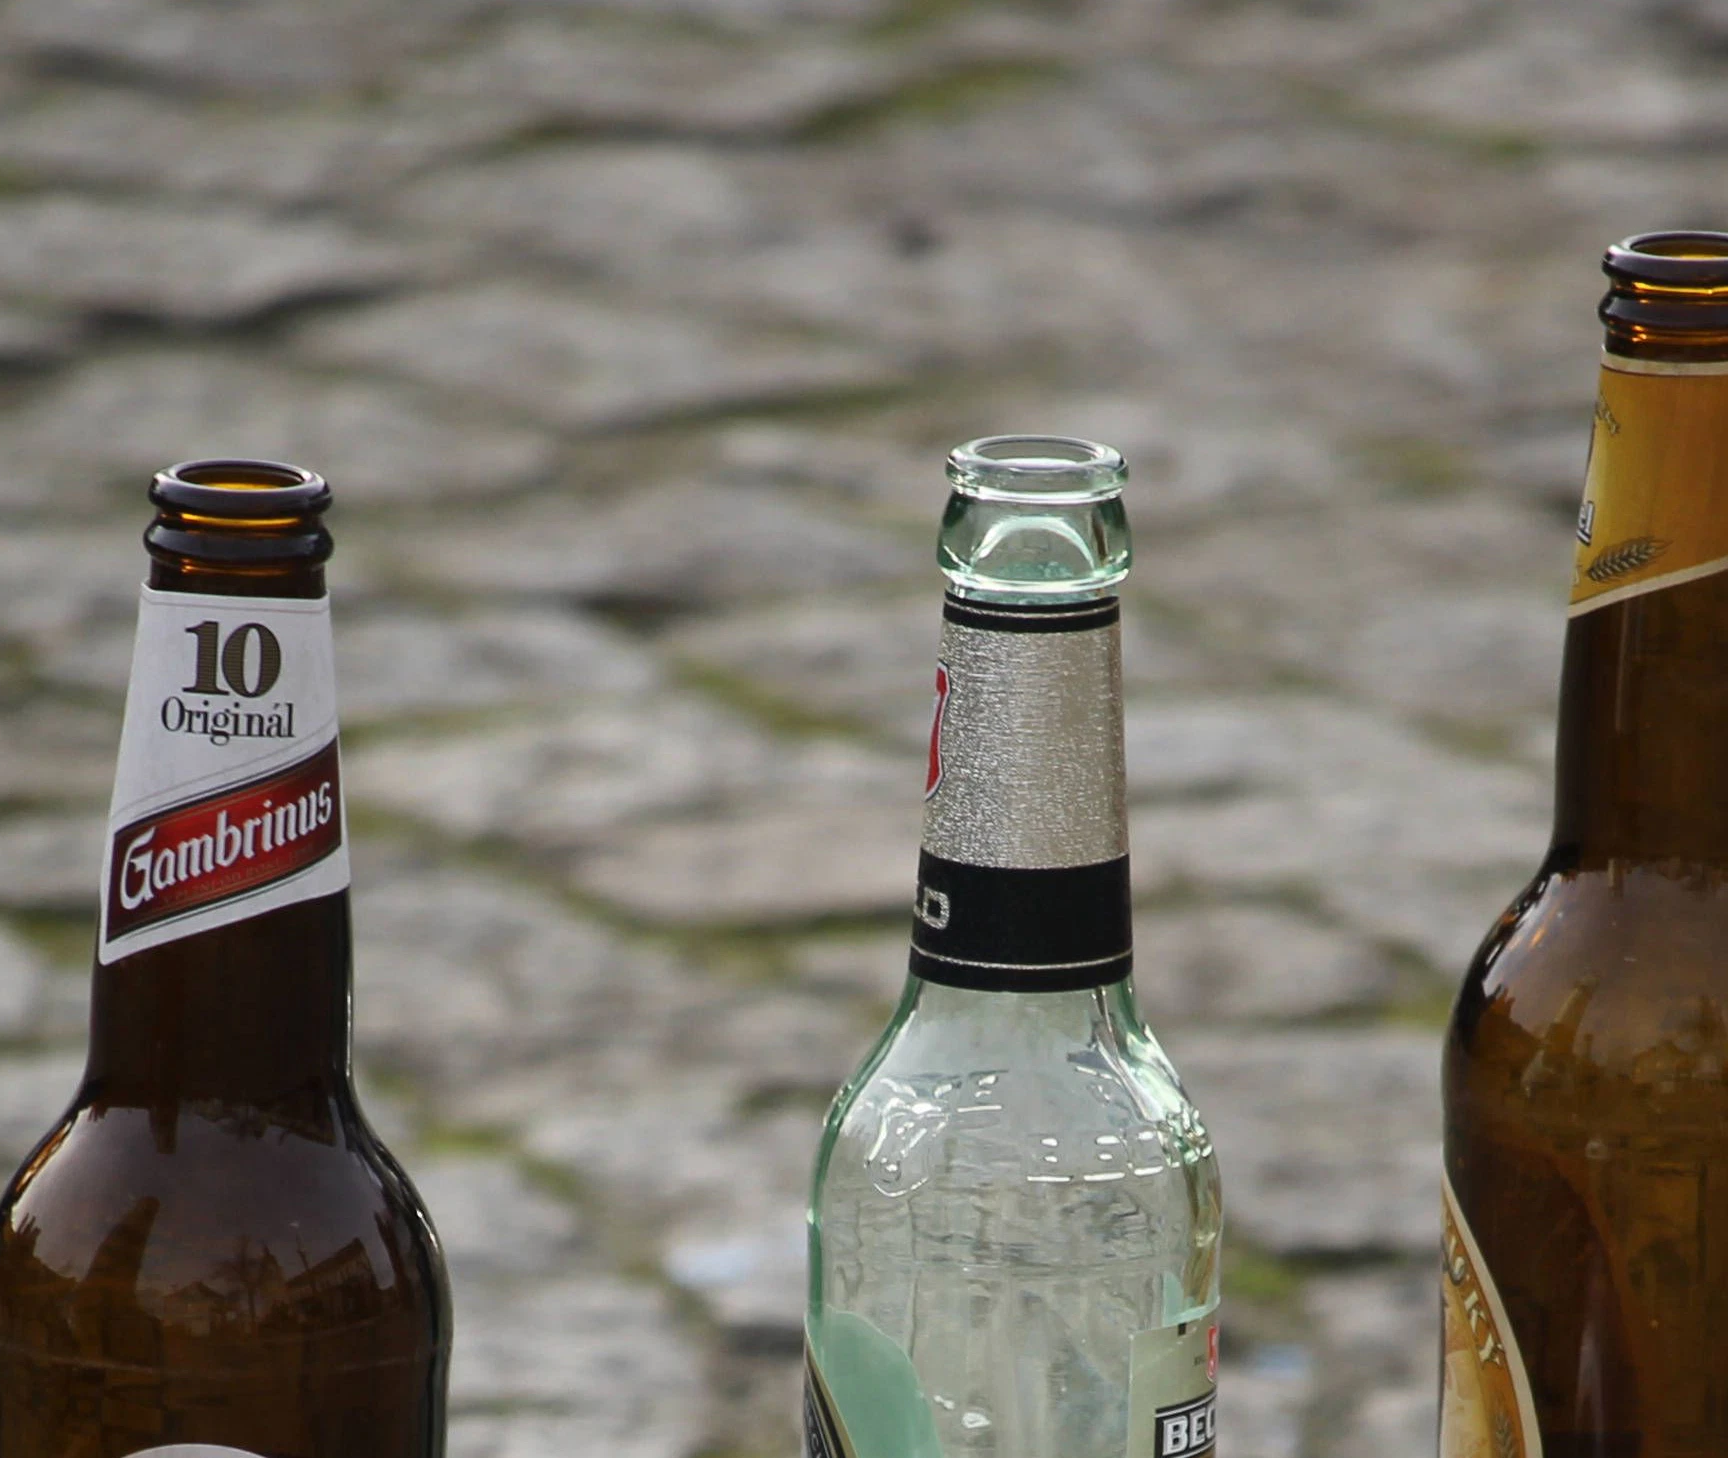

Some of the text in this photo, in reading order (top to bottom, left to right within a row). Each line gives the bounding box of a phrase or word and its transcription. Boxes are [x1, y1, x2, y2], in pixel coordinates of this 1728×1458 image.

[182, 621, 282, 698] 10
[161, 695, 295, 746] Originál
[120, 781, 332, 910] Gambrinus
[916, 888, 950, 928] D
